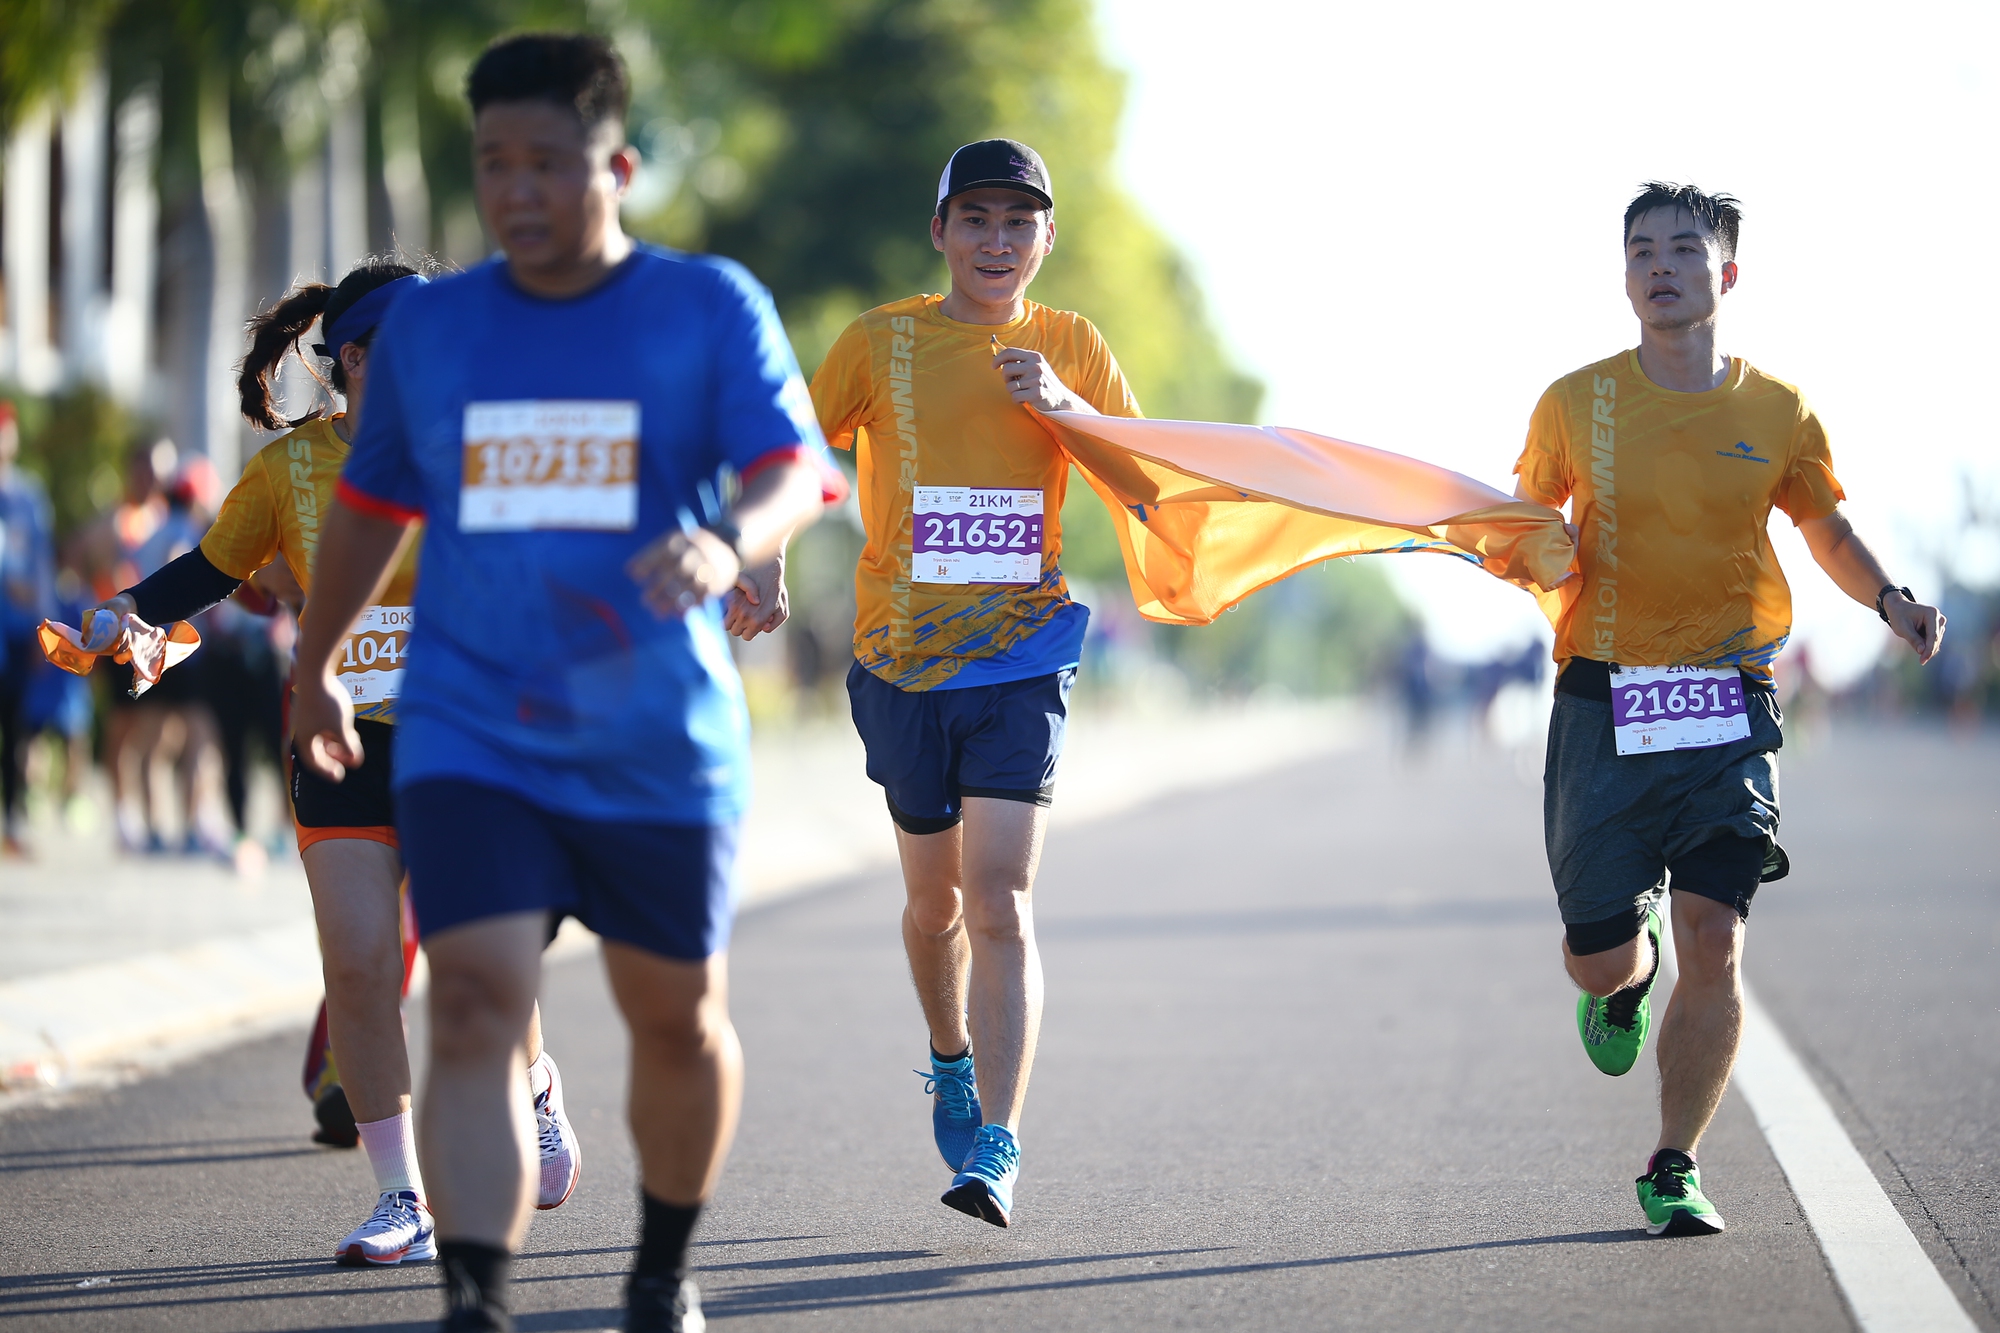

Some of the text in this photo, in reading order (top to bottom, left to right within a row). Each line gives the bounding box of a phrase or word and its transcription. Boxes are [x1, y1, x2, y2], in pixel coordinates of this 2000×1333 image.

[889, 315, 918, 494] RUNNERS
[1591, 373, 1618, 571] RUNNERS
[288, 438, 319, 575] NNERS
[969, 494, 1012, 508] 21KM
[924, 518, 1026, 548] 21652
[381, 611, 416, 625] 10K
[1595, 577, 1618, 624] LOI
[1624, 684, 1725, 718] 21651
